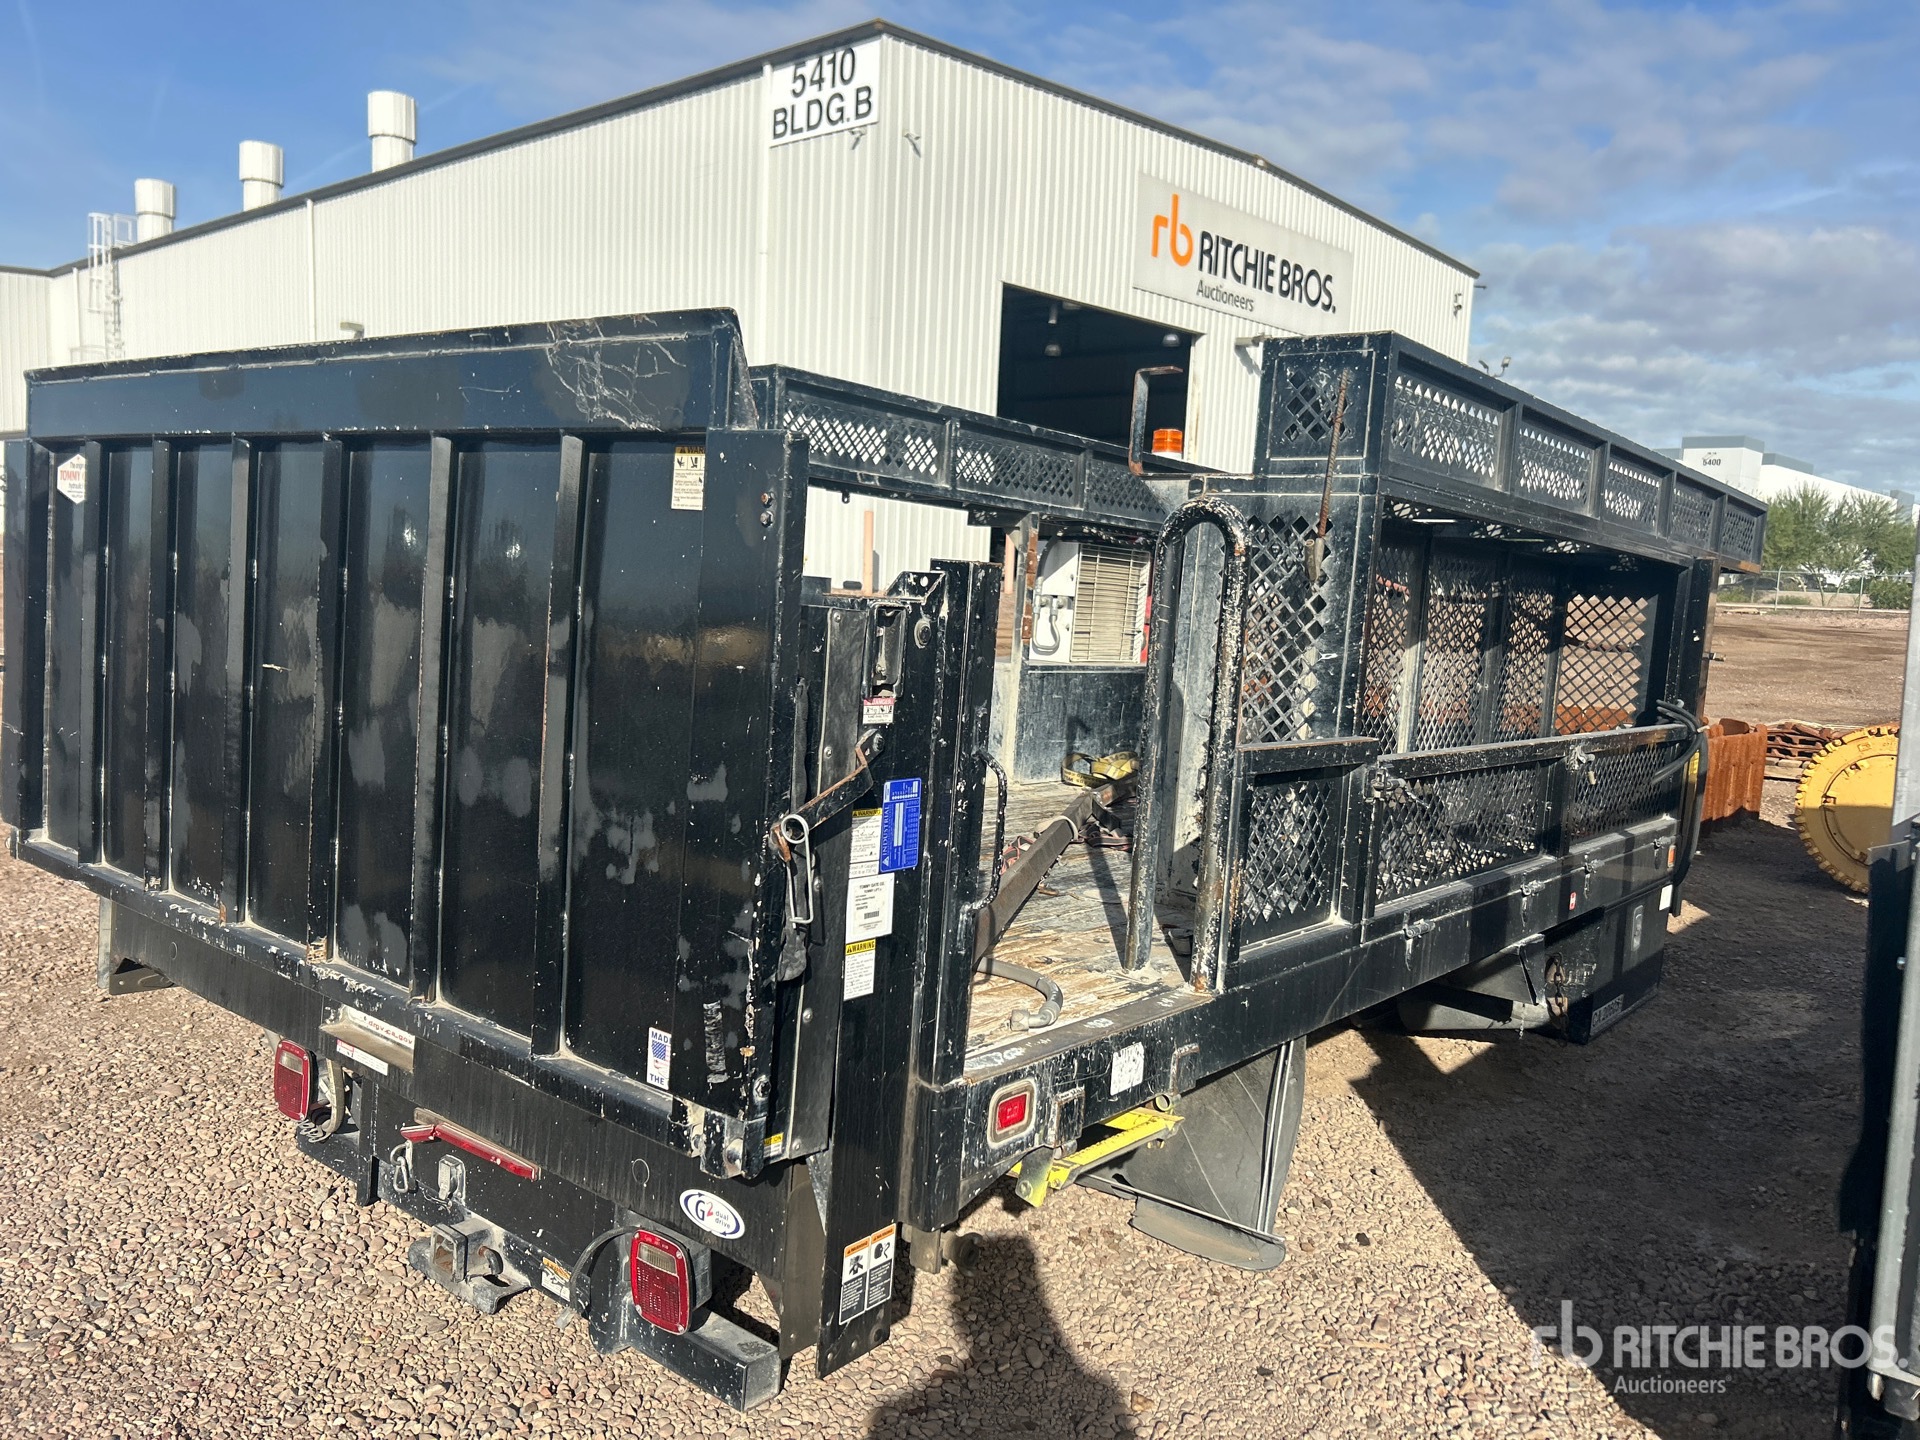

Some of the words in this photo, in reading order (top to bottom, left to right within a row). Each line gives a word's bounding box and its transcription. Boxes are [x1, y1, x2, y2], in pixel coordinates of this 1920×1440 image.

[791, 47, 856, 99] 5410
[1151, 193, 1194, 267] rb
[1197, 230, 1276, 294] RITCHIE
[1277, 258, 1337, 314] BROS.
[1196, 279, 1255, 313] Auctioneers
[60, 470, 80, 481] TOMMY
[882, 806, 891, 856] INDUSTRIAL
[852, 940, 875, 952] WARNING
[651, 1030, 671, 1045] MAD
[649, 1073, 665, 1086] THE
[715, 1210, 729, 1221] dual
[714, 1218, 731, 1229] drive
